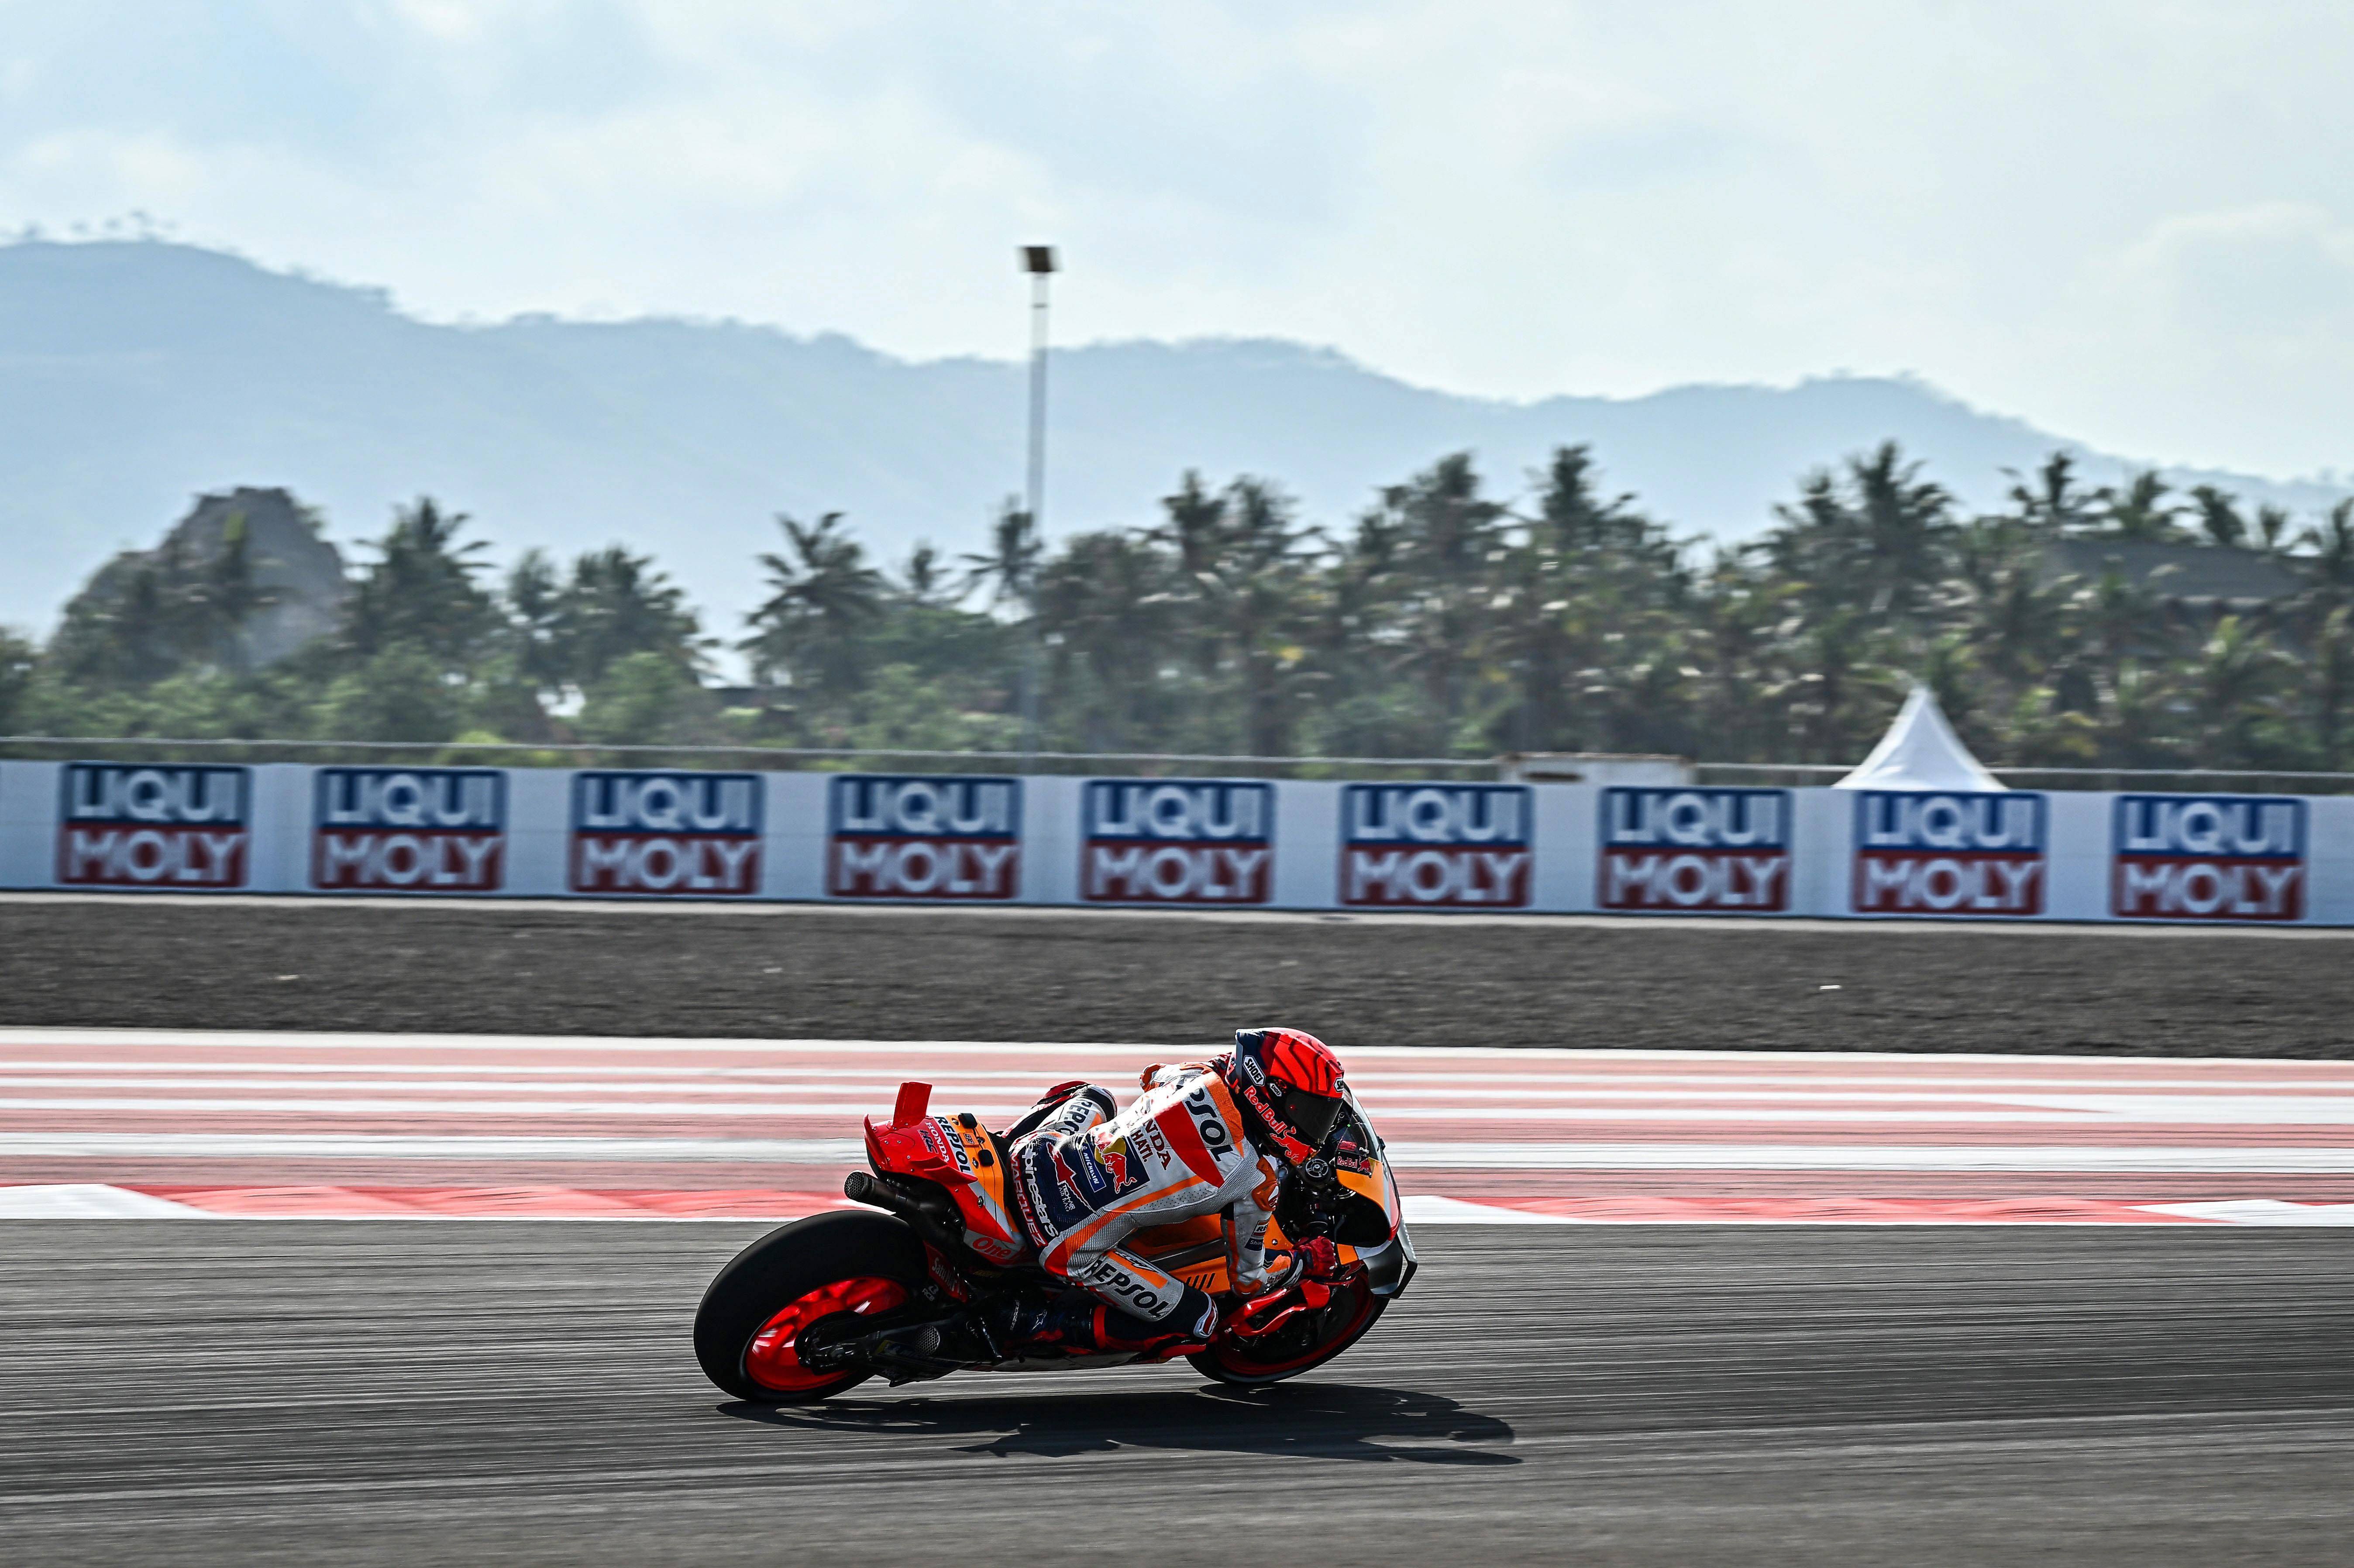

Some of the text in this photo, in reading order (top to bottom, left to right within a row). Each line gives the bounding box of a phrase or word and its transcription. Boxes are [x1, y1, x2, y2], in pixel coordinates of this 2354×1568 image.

[72, 770, 238, 821] LIQUI
[327, 774, 493, 825] LIQUI
[585, 777, 750, 829] LIQUI
[843, 781, 1008, 832] LIQUI
[1096, 786, 1262, 837] LIQUI
[1354, 790, 1520, 841] LIQUI
[1613, 794, 1779, 845] LIQUI
[1868, 798, 2034, 849] LIQUI
[2127, 802, 2293, 853] LIQUI
[69, 830, 246, 881] MOLY
[324, 834, 502, 885] MOLY
[582, 838, 759, 889] MOLY
[840, 842, 1017, 893] MOLY
[1093, 846, 1270, 897] MOLY
[1351, 850, 1528, 901] MOLY
[1610, 854, 1787, 905] MOLY
[1865, 858, 2042, 909] MOLY
[2124, 863, 2301, 913] MOLY
[1245, 1058, 1263, 1083] SHOEI
[1271, 1084, 1281, 1096] SHOEI
[925, 1122, 950, 1163] HONDA
[934, 1116, 971, 1172] REPSOL
[1143, 1118, 1172, 1170] NDA
[1185, 1087, 1233, 1162] PSOL
[1083, 1152, 1100, 1185] MICHELIN
[973, 1237, 1012, 1257] One
[1084, 1259, 1169, 1317] REPSOL
